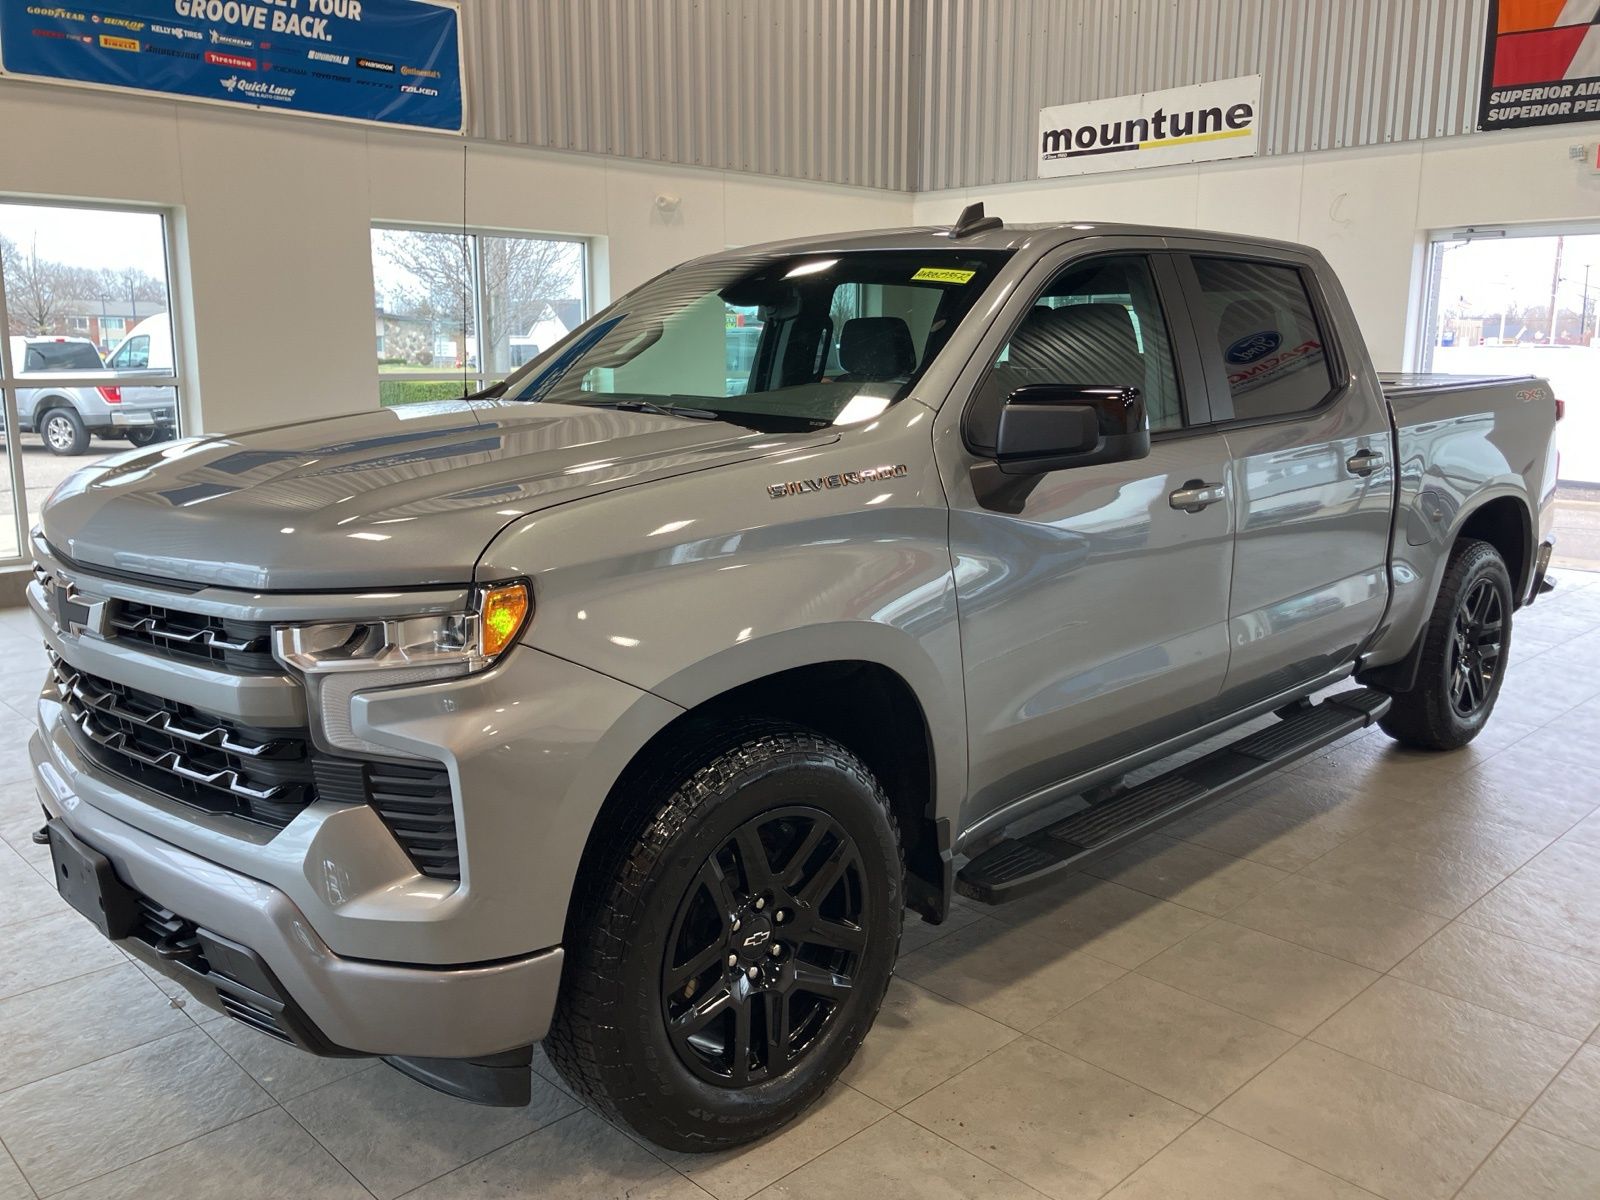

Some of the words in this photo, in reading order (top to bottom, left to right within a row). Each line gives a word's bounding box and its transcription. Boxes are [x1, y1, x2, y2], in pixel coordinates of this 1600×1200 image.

[27, 6, 85, 22] GOODYEAR
[103, 17, 145, 32] DUNLOP
[151, 24, 172, 36] KELLY
[183, 29, 203, 40] TIRES
[220, 36, 252, 46] MICHELIN
[175, 0, 268, 30] GROOVE
[271, 10, 332, 41] BACK.
[103, 37, 137, 50] PIRELLI
[210, 53, 252, 68] Firestone
[401, 85, 438, 97] FALKEN
[237, 79, 268, 93] Quick
[268, 84, 297, 97] Lane
[1490, 84, 1573, 104] SUPERIOR
[1042, 103, 1253, 153] mountune
[1487, 101, 1571, 121] SUPERIOR
[766, 463, 908, 499] SILVERADO
